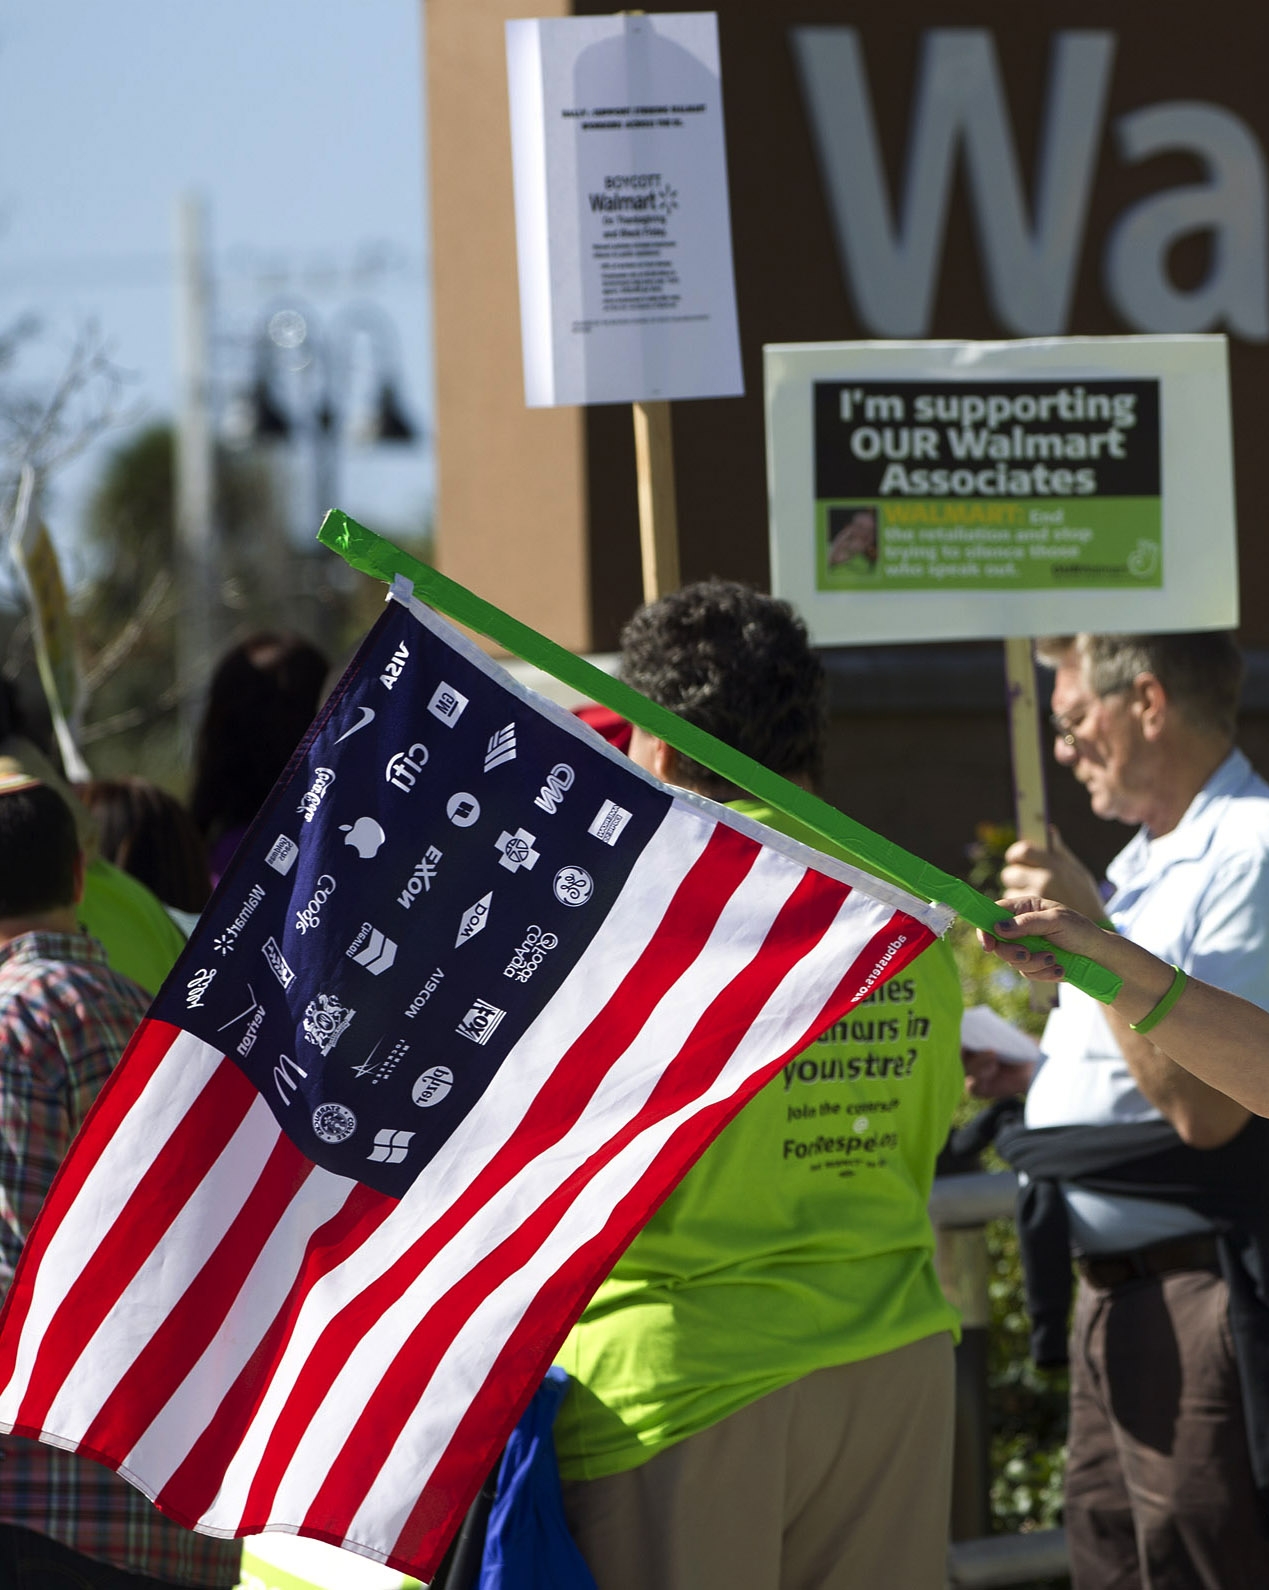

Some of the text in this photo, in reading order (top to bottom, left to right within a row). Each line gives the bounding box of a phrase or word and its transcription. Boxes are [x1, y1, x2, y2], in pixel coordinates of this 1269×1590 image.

[604, 173, 661, 190] BOYCOTT
[589, 191, 656, 213] Walmart
[840, 387, 1137, 429] I'm supporting
[850, 426, 1127, 461] OUR Walmart
[879, 464, 1097, 496] Associates
[885, 503, 1064, 525] WALMART: End
[885, 525, 1093, 546] the retaliation and stop
[884, 541, 1081, 564] trying to silence those
[885, 562, 922, 578] who
[927, 560, 980, 582] speak
[907, 1010, 931, 1040] in
[848, 1048, 917, 1081] stre?
[787, 1104, 817, 1122] Join
[819, 1100, 841, 1116] the
